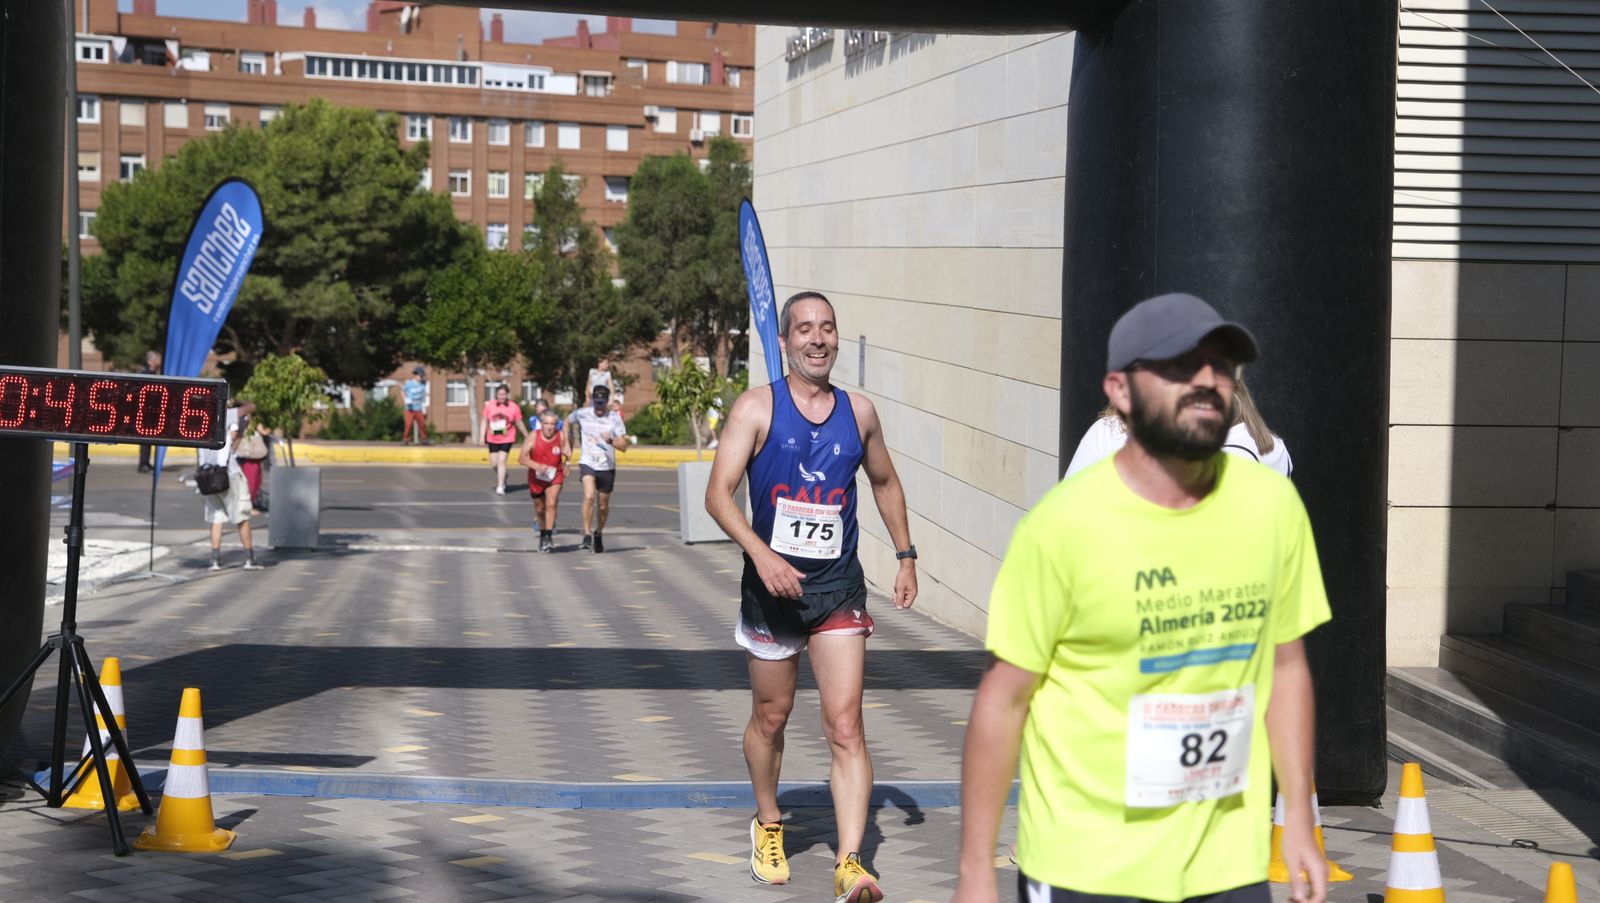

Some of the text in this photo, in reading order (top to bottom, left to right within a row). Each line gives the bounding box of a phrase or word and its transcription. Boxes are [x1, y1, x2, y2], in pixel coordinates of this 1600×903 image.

[790, 519, 834, 541] 175
[1135, 582, 1268, 615] Medio Maratón
[1139, 600, 1270, 636] Almería 2022
[1180, 730, 1228, 768] 82
